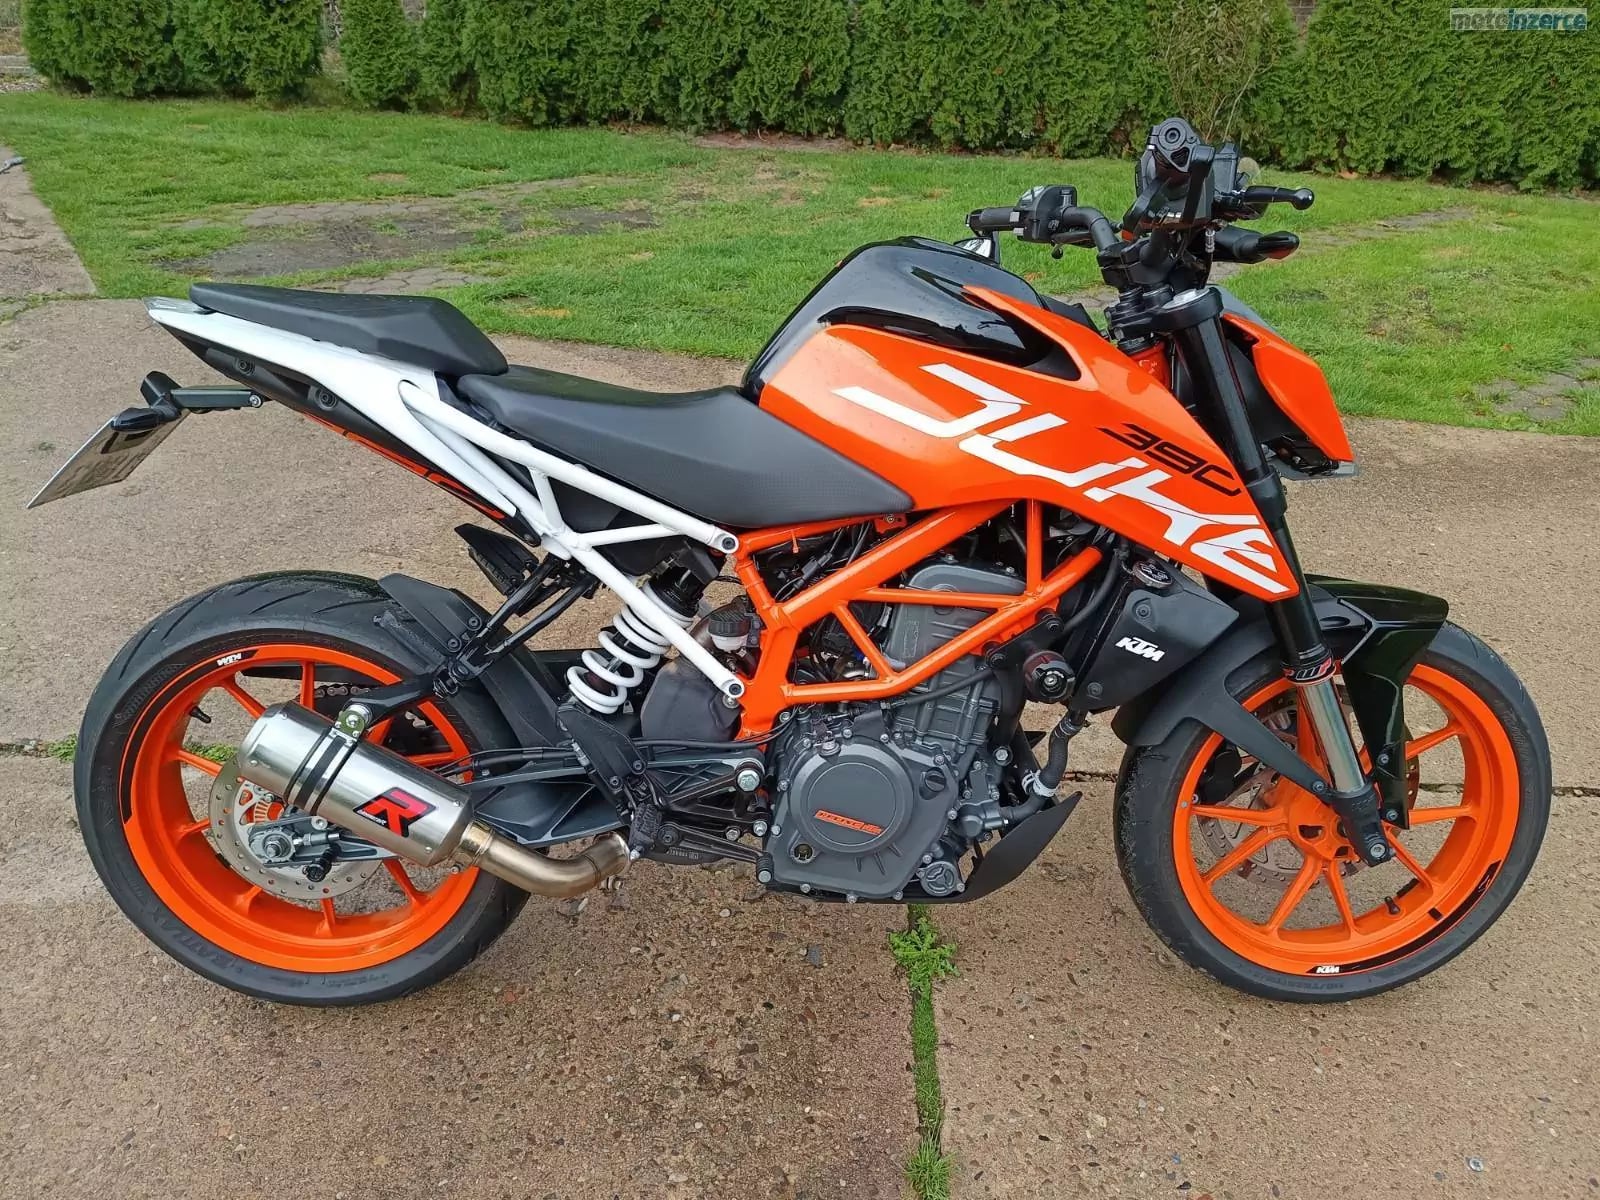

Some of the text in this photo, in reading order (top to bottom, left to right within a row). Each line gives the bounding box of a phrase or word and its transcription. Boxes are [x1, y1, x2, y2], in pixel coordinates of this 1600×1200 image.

[832, 363, 1290, 594] DUKE
[1115, 636, 1166, 662] KTM
[1316, 965, 1340, 974] KTM
